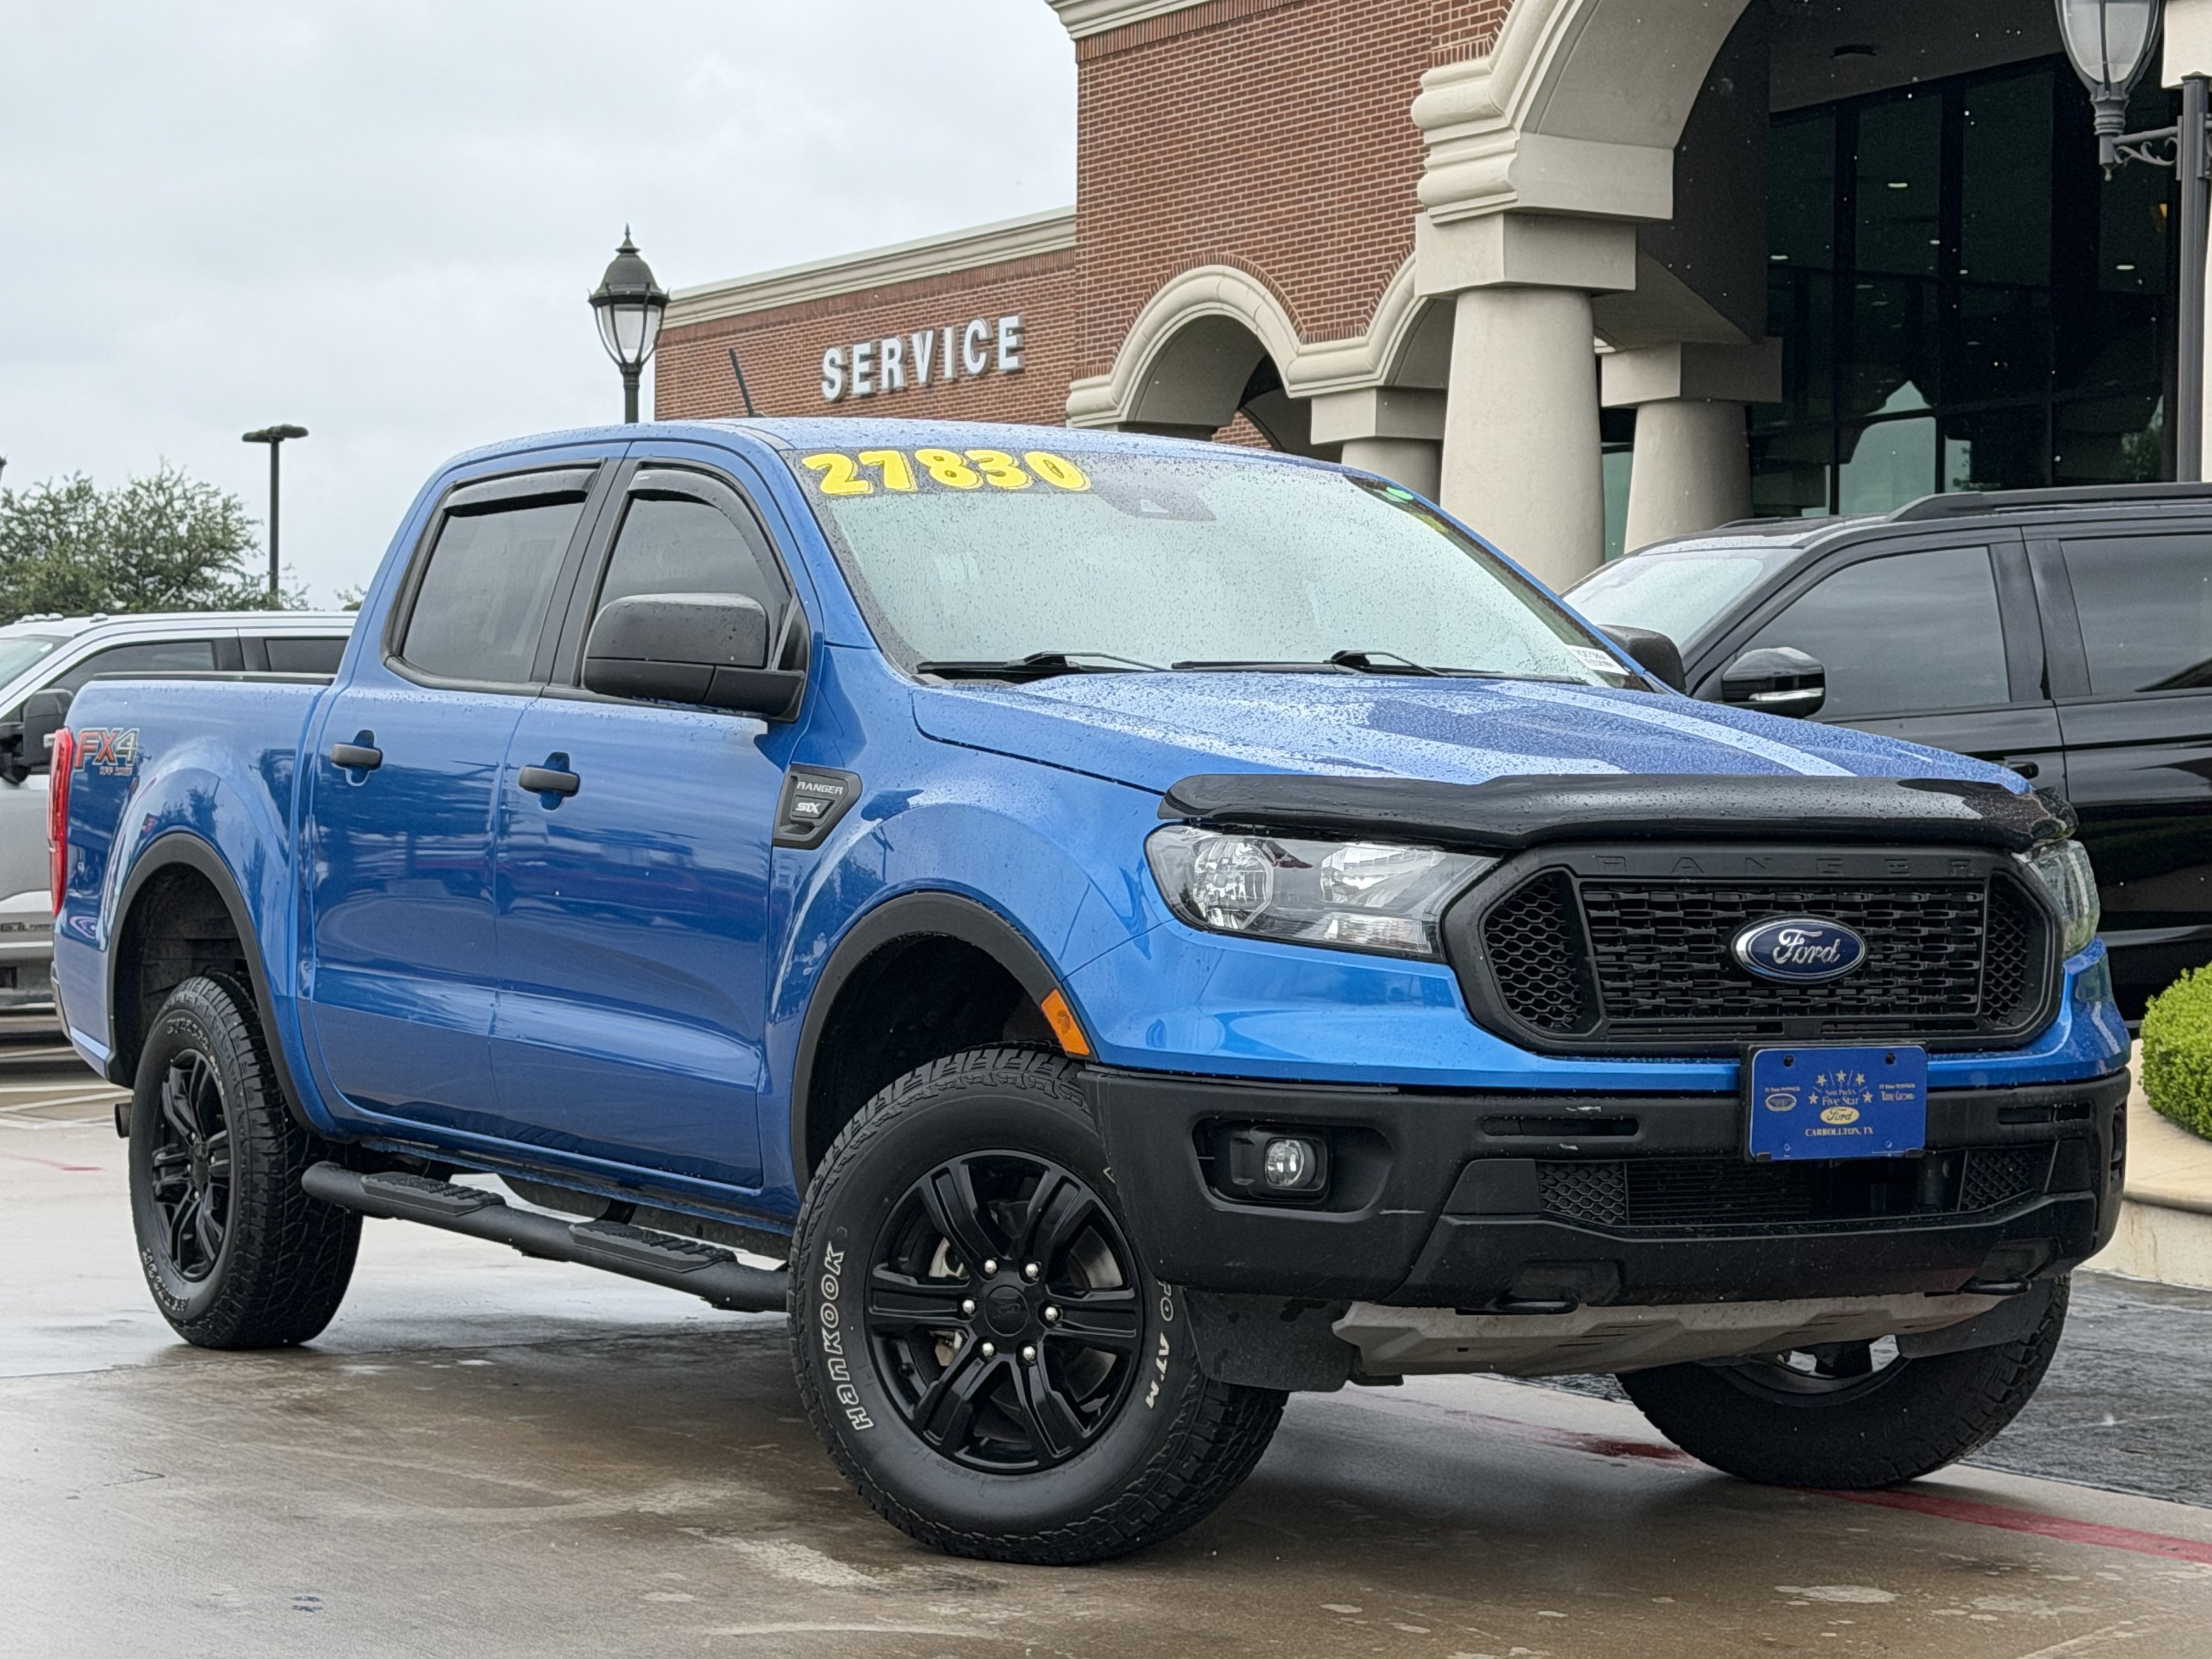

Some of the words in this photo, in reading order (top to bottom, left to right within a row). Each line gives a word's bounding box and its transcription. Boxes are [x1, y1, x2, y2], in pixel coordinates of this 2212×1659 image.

[822, 314, 1025, 402] SERVICE
[802, 449, 1091, 494] 27830
[74, 727, 139, 772] FX4
[795, 802, 821, 814] STX
[797, 781, 844, 795] RANGER
[1772, 929, 1842, 964] Ford
